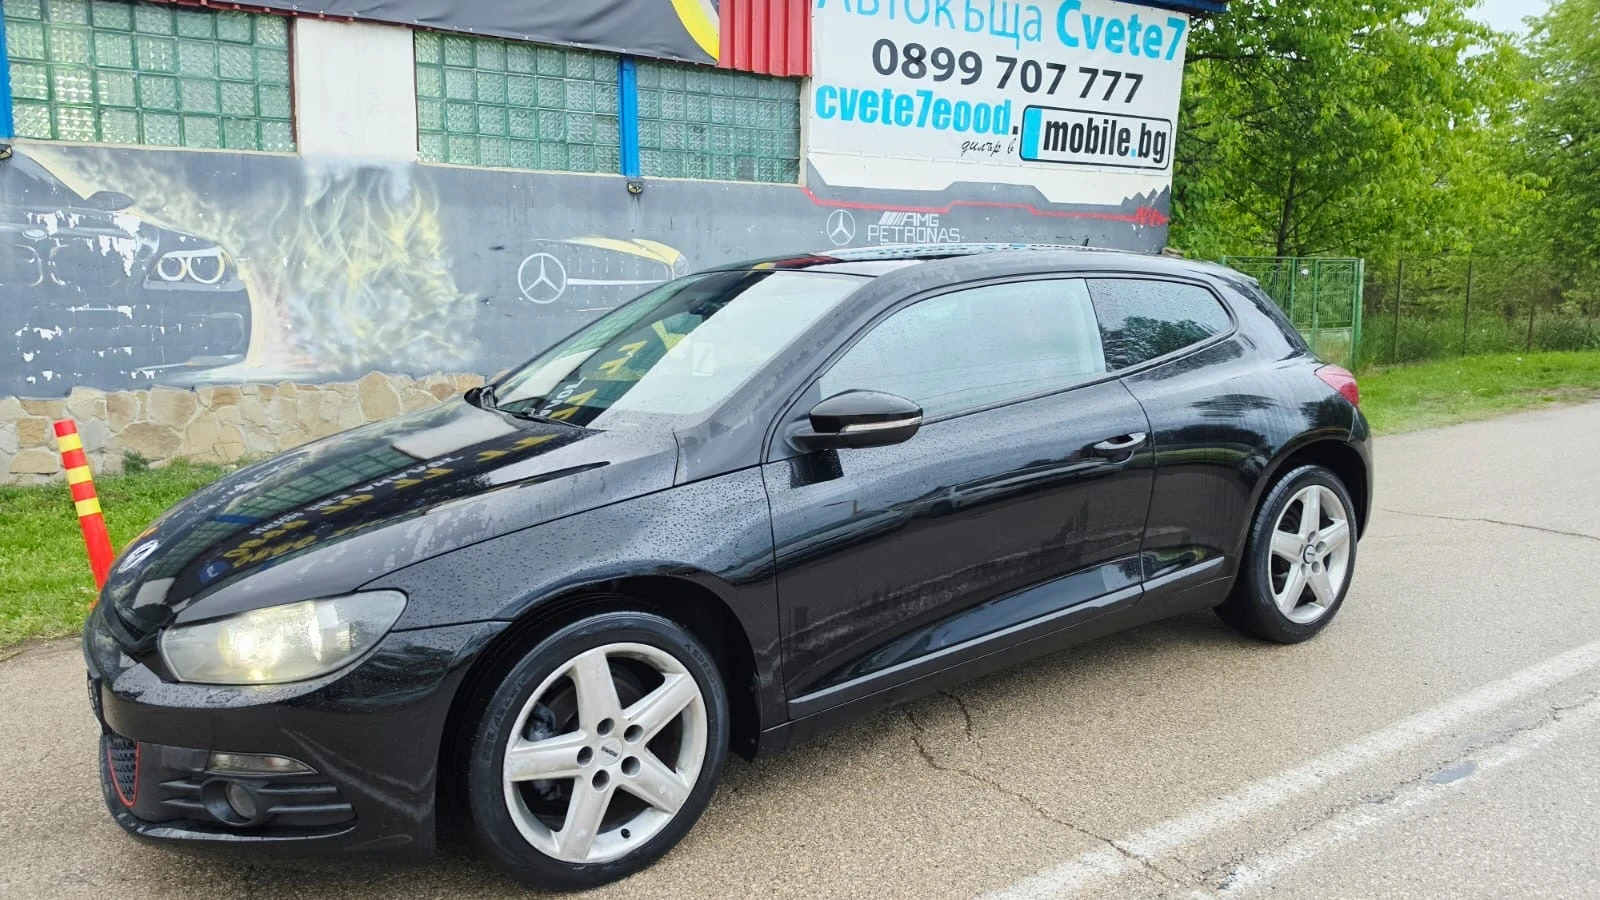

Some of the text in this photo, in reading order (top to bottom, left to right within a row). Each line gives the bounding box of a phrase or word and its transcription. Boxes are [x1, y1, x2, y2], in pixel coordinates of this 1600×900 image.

[817, 0, 1042, 49] окъща
[1056, 0, 1186, 61] Cvete7
[872, 38, 1144, 103] 0899 707 777
[1043, 117, 1167, 164] mobile.bg
[867, 224, 960, 243] PETRONAS
